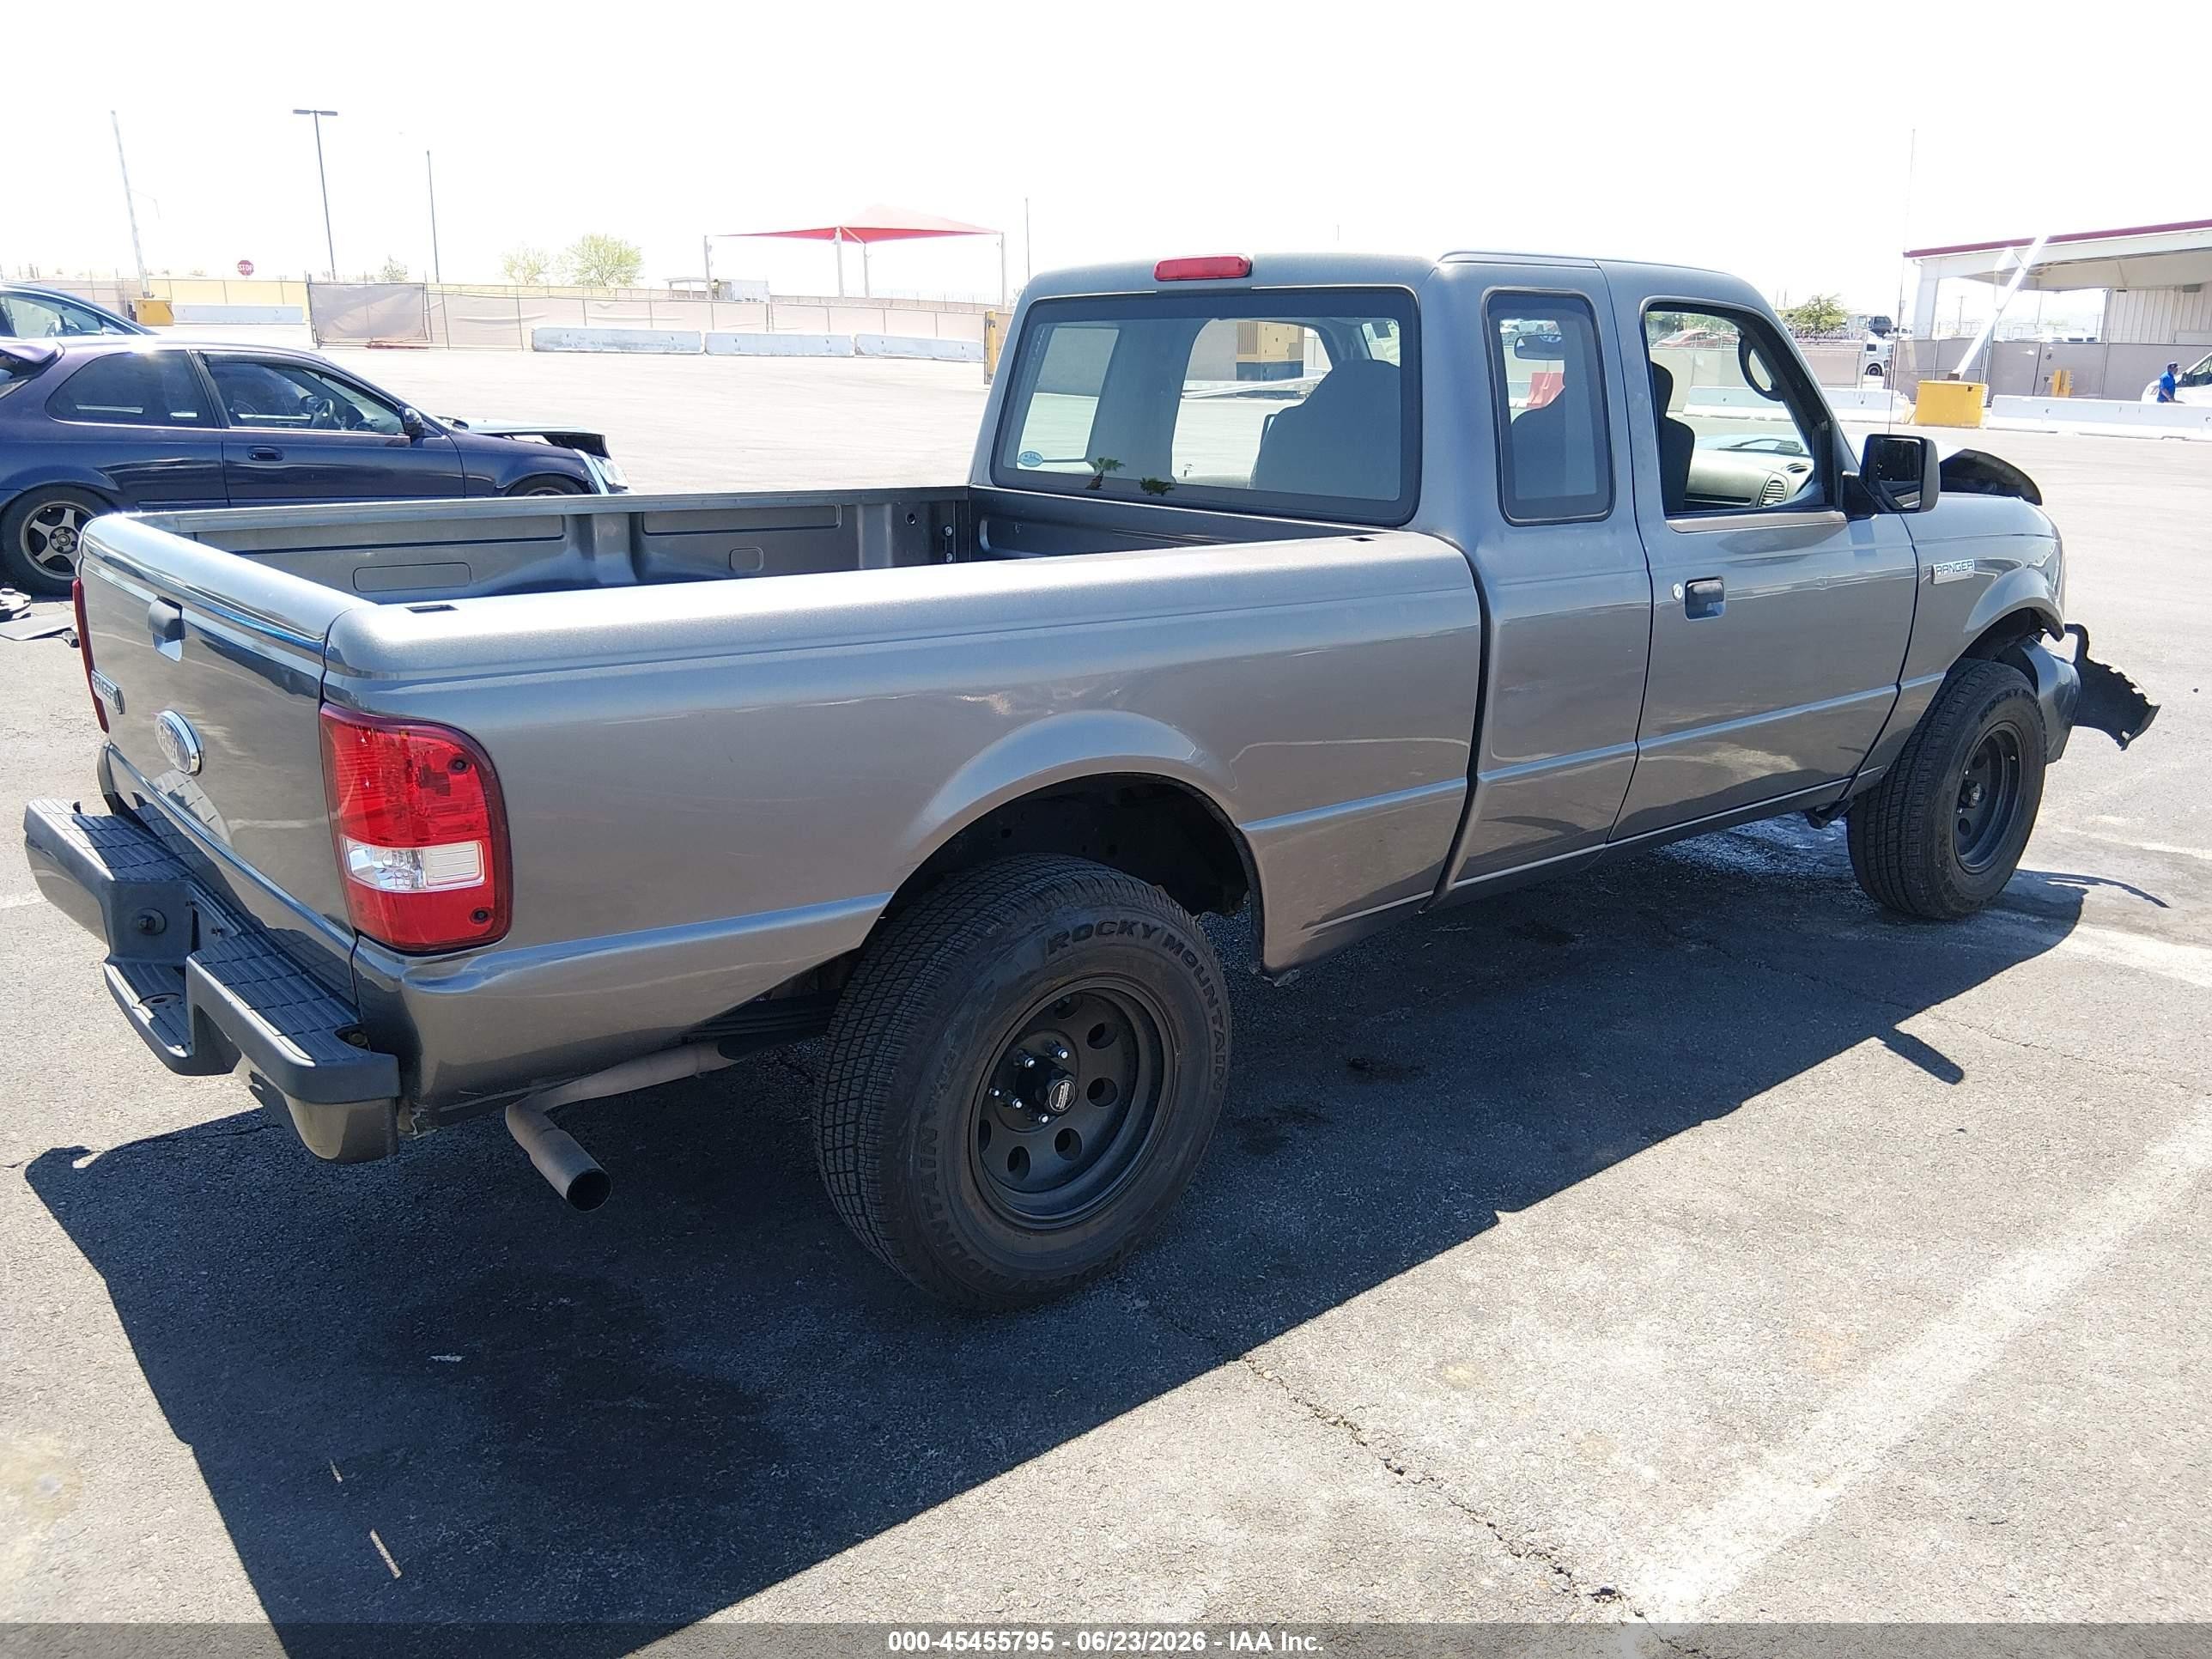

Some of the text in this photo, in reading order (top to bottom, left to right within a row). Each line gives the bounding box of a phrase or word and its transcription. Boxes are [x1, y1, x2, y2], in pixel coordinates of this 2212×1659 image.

[238, 264, 253, 272] STOP
[1936, 560, 1973, 576] RANGER
[1047, 920, 1226, 1092] ROCKY MOUNTAIN
